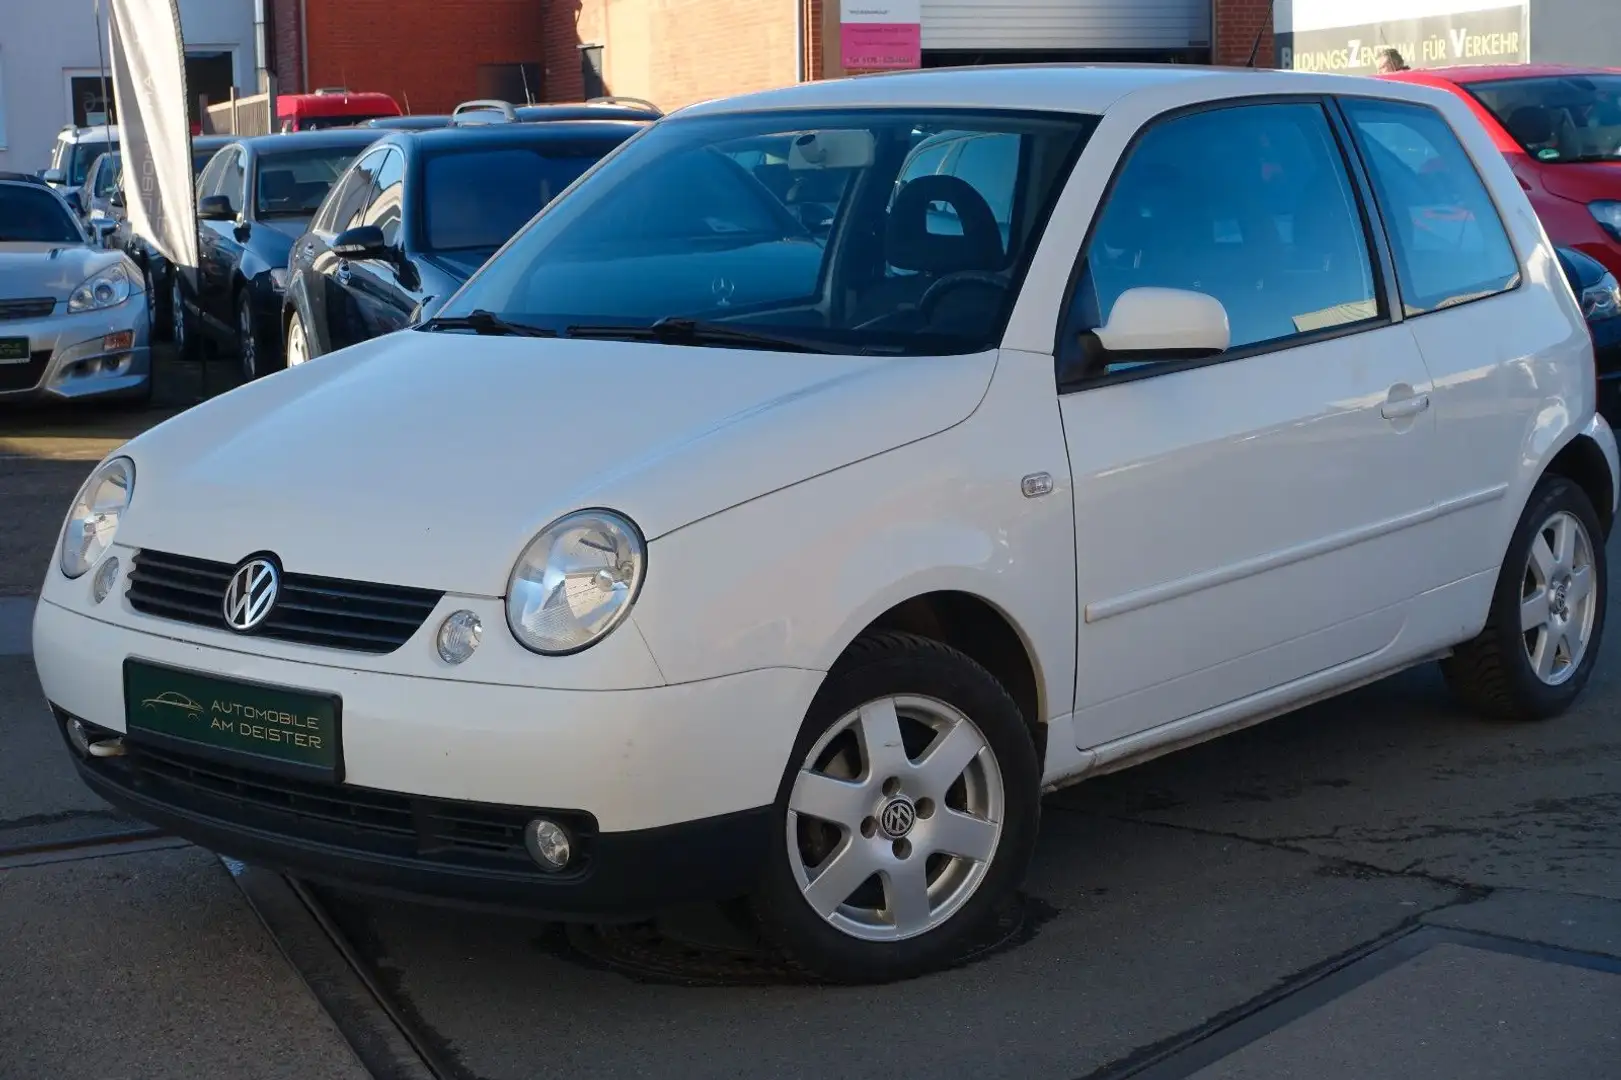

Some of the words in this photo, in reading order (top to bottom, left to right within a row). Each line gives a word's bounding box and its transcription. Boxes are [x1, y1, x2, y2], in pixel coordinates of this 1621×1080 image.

[1422, 34, 1447, 61] FÜR
[1450, 27, 1519, 58] VERKEHR
[211, 699, 320, 730] AUTOMOBILE
[210, 716, 234, 733] AM
[239, 723, 322, 749] DEISTER
